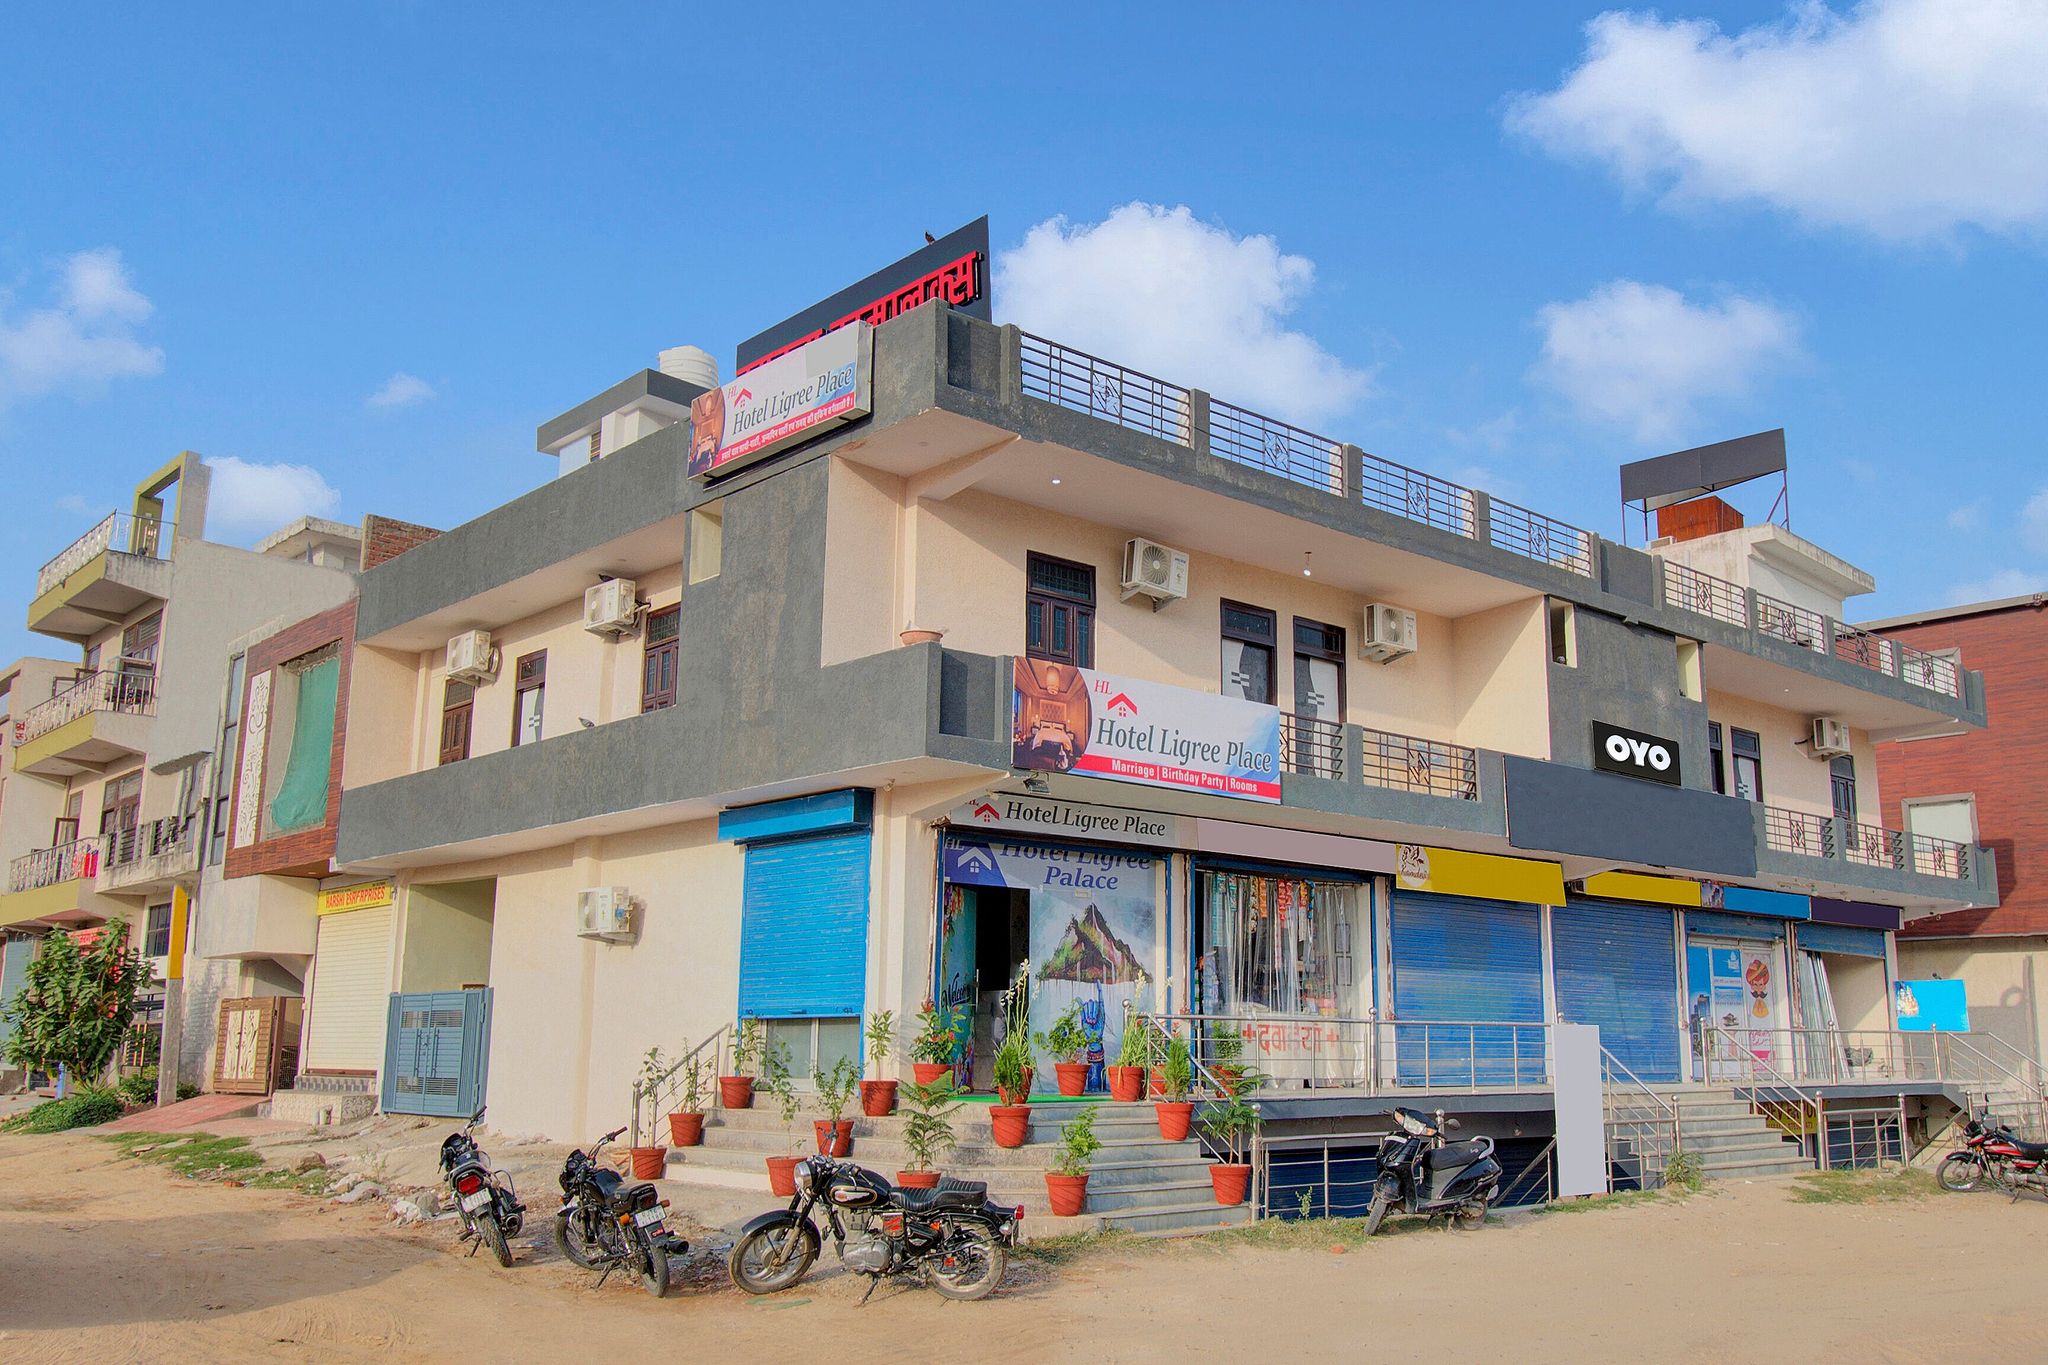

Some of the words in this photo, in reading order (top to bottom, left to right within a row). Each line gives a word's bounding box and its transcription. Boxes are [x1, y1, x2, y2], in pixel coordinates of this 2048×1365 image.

[733, 398, 769, 435] Hotel
[771, 385, 813, 419] Ligree
[816, 366, 852, 402] Place
[1094, 679, 1112, 694] HL
[1096, 718, 1154, 753] Hotel
[1159, 728, 1221, 765] Ligree
[1225, 740, 1271, 772] Place
[1605, 734, 1671, 771] OYO
[1112, 759, 1154, 777] Marriage
[1162, 769, 1200, 786] Birthday
[1201, 774, 1224, 790] Party
[1230, 777, 1258, 793] Rooms
[1004, 800, 1060, 824] Hotel
[1063, 807, 1119, 832] Ligree
[1123, 815, 1166, 837] Place
[1043, 865, 1118, 890] Palace
